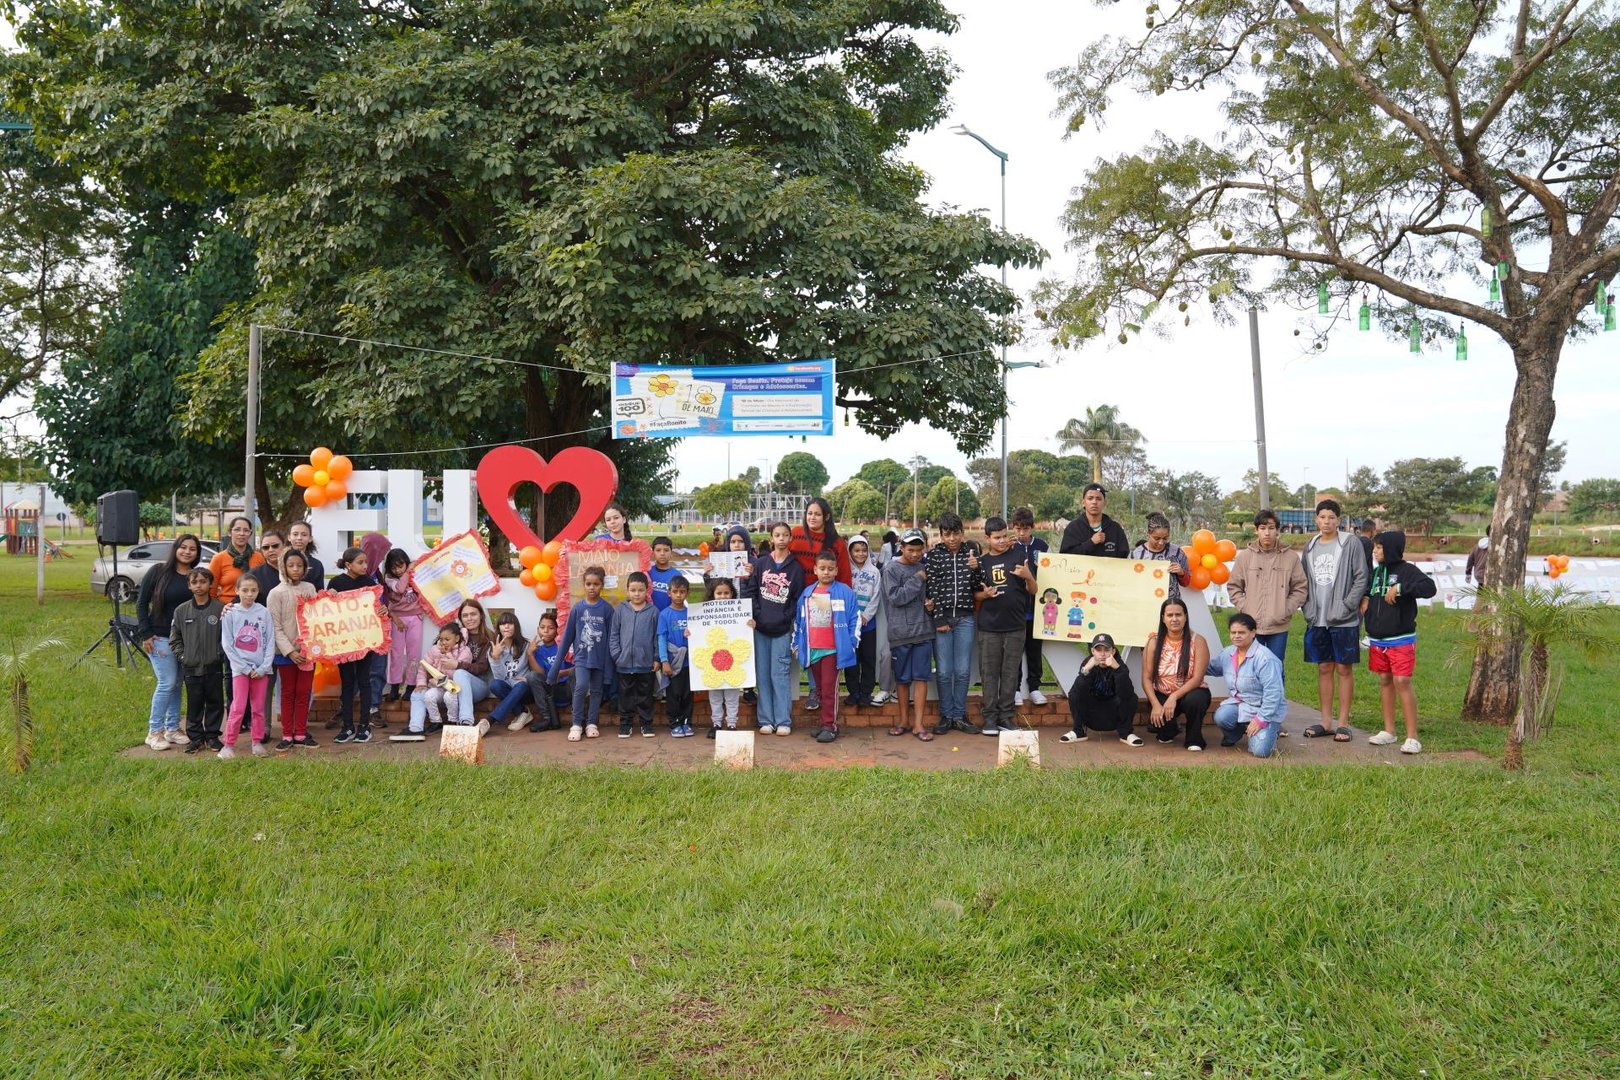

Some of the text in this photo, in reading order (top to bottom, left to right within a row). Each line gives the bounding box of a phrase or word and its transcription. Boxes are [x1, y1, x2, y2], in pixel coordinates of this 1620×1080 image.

[682, 403, 714, 414] DE MAIO
[578, 549, 620, 562] MAIO
[568, 562, 634, 578] LAANJA
[992, 569, 1006, 580] fit
[688, 612, 751, 621] RESPONSABILIDADE
[311, 614, 380, 638] ARANJA
